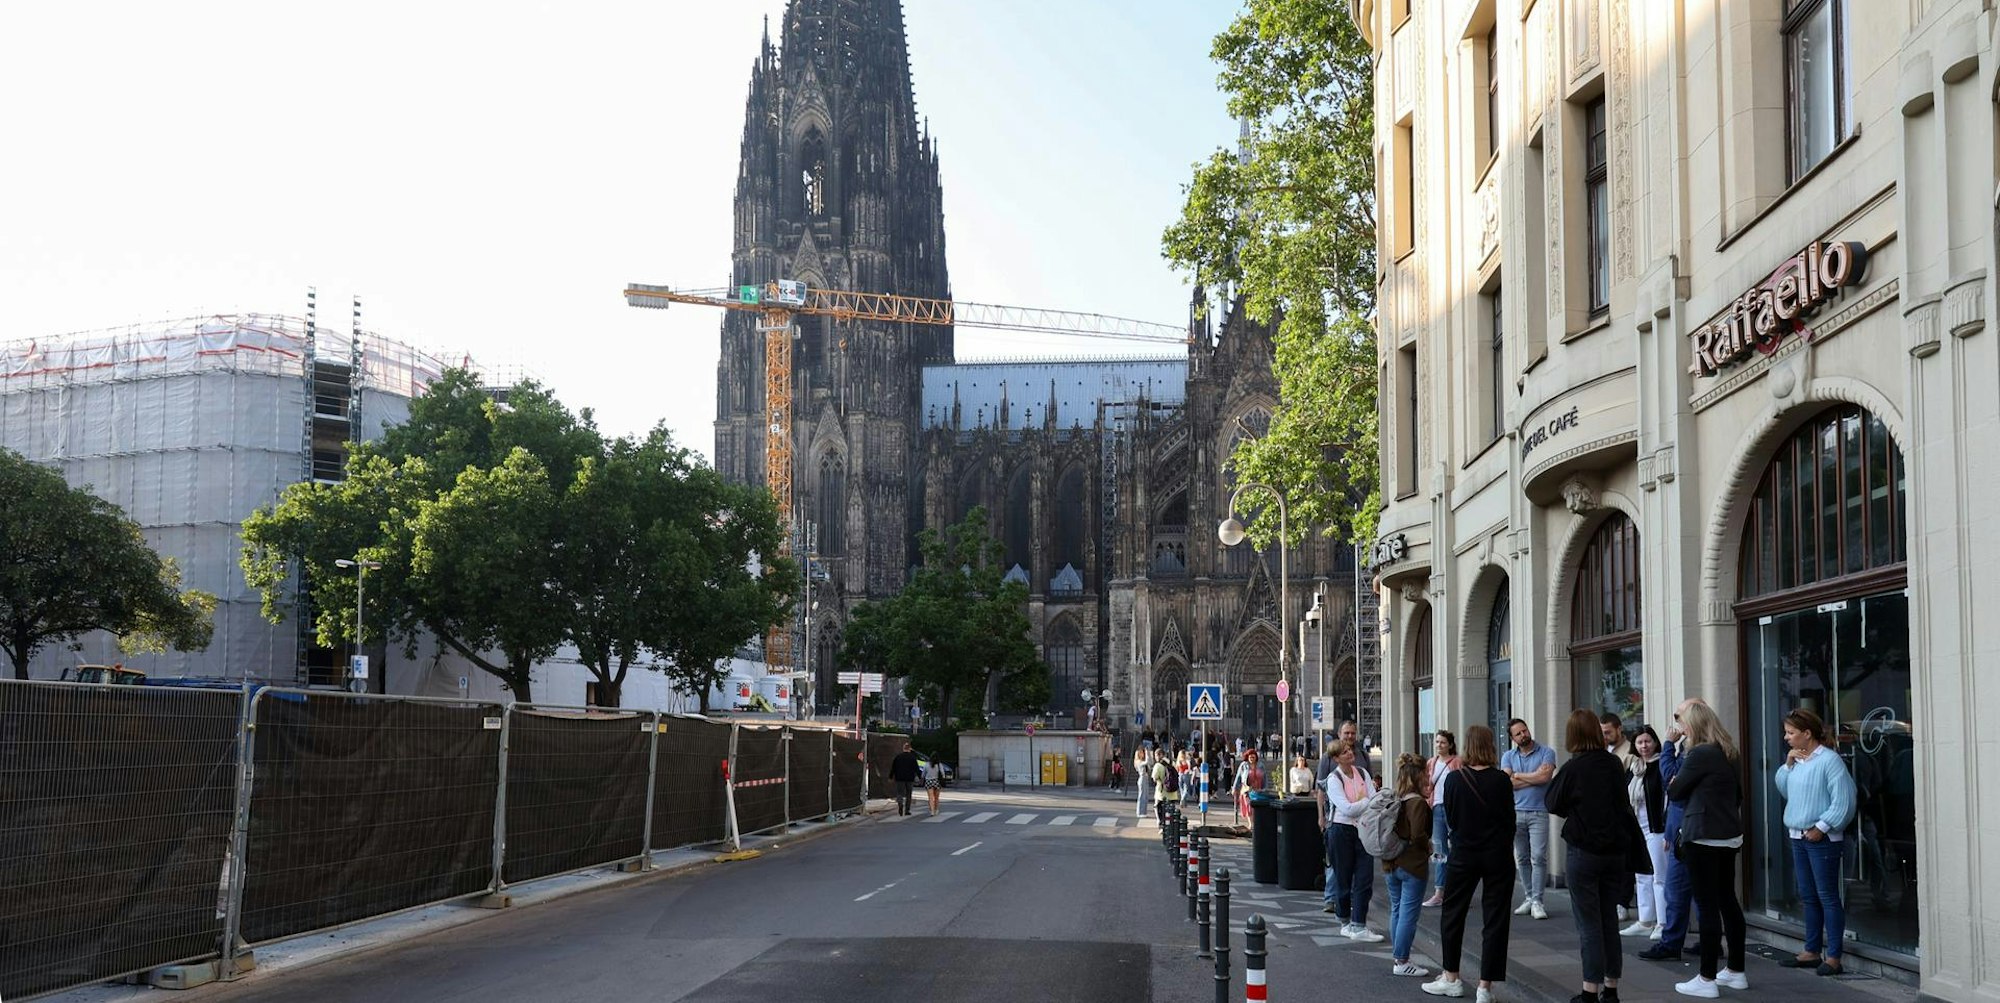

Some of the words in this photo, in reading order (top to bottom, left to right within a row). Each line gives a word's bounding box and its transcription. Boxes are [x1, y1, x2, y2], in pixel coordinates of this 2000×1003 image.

[1692, 241, 1863, 377] Raffaello
[1533, 426, 1548, 447] DEL
[1549, 406, 1579, 437] CAFÉ
